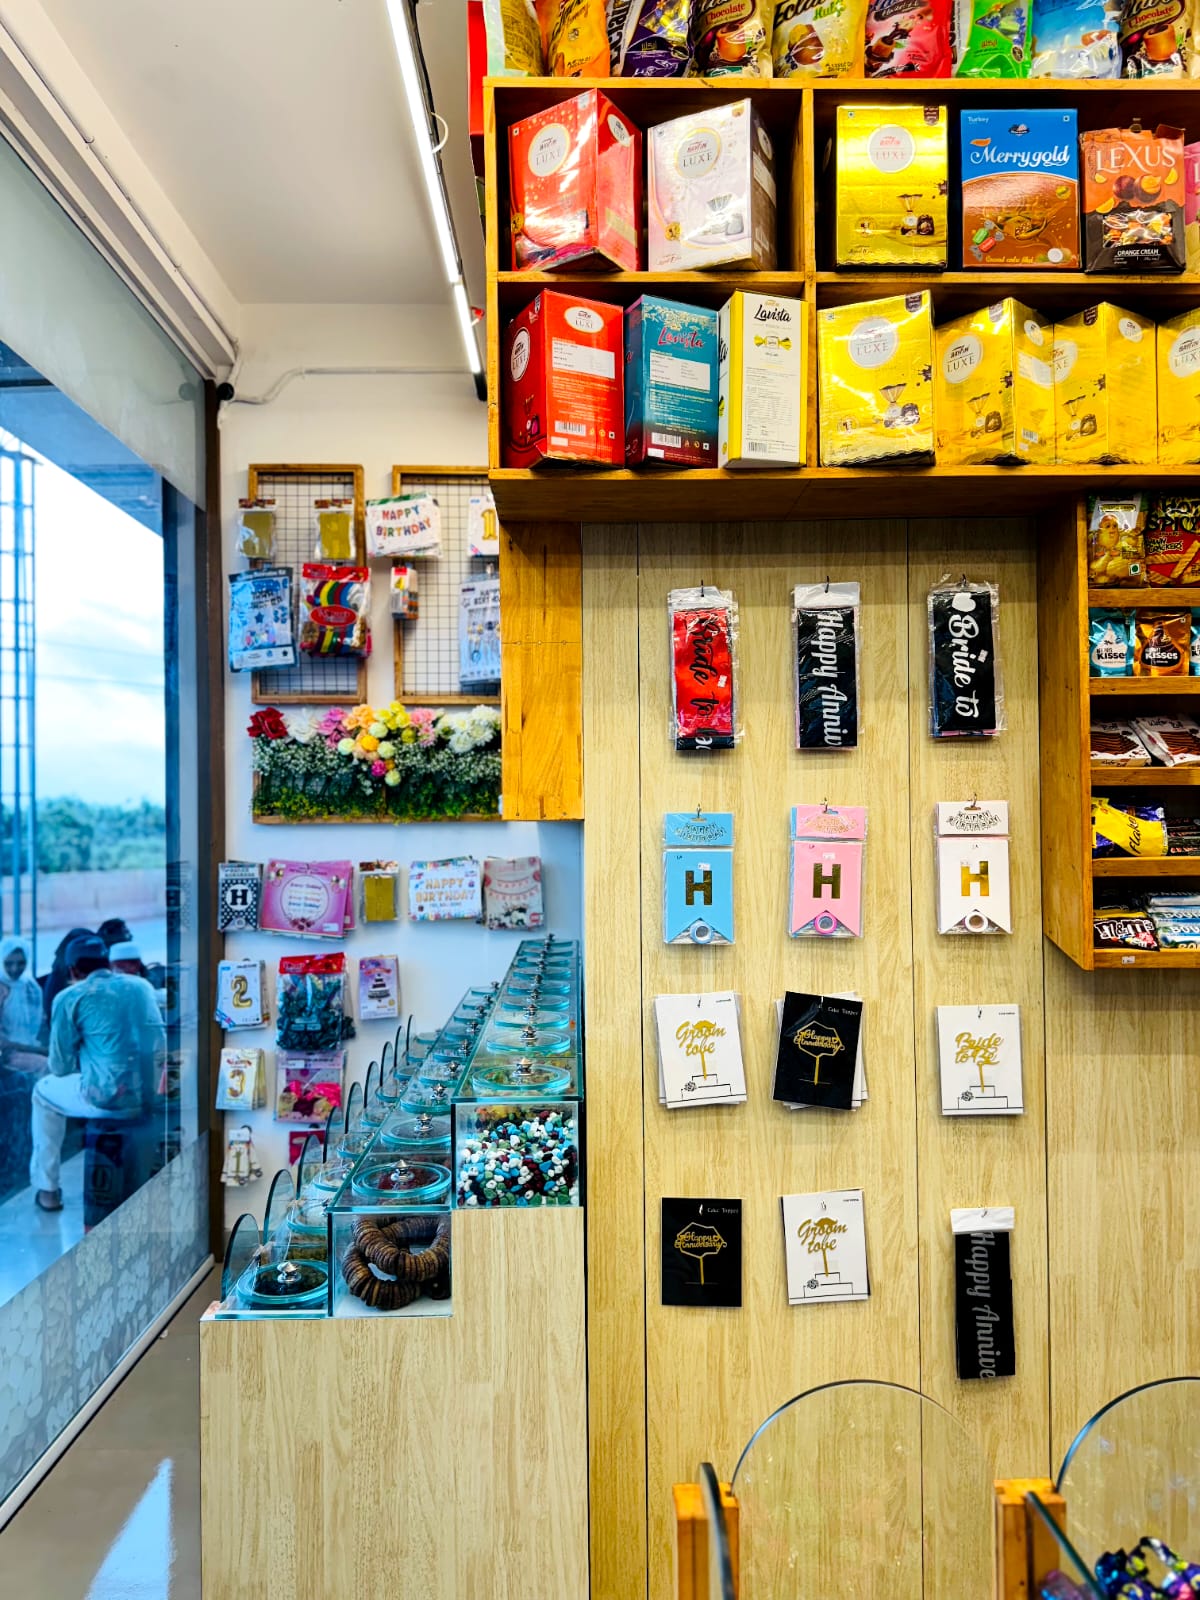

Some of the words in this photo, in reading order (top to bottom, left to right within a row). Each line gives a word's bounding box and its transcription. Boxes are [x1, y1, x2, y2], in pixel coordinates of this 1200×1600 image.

[706, 2, 746, 25] Chocolate
[1128, 6, 1175, 28] Chocolate
[968, 116, 989, 124] Turkey
[683, 152, 712, 168] LUXE
[875, 151, 906, 161] LUXE
[970, 144, 1071, 168] Merrygold
[1096, 142, 1176, 174] LEXUS
[754, 304, 792, 323] Lavista
[657, 327, 705, 349] Lavista
[857, 342, 889, 356] LUXE
[947, 355, 975, 373] LUXE
[382, 504, 420, 521] HAPPY
[376, 516, 432, 537] BIRTHDAY
[811, 609, 844, 679] Happy
[948, 614, 980, 688] Bride
[817, 683, 848, 746] Anniv
[954, 689, 980, 719] to
[1128, 816, 1142, 855] Flake
[424, 878, 465, 890] HAPPY
[685, 870, 713, 906] H
[813, 862, 841, 899] H
[961, 860, 990, 897] H
[230, 888, 249, 906] H
[415, 889, 476, 904] BIRTHDAY
[230, 974, 253, 1009] 2
[675, 1019, 727, 1049] Groom
[955, 1031, 1004, 1049] Bride
[797, 1217, 848, 1246] Groom
[964, 1231, 996, 1298] Happy
